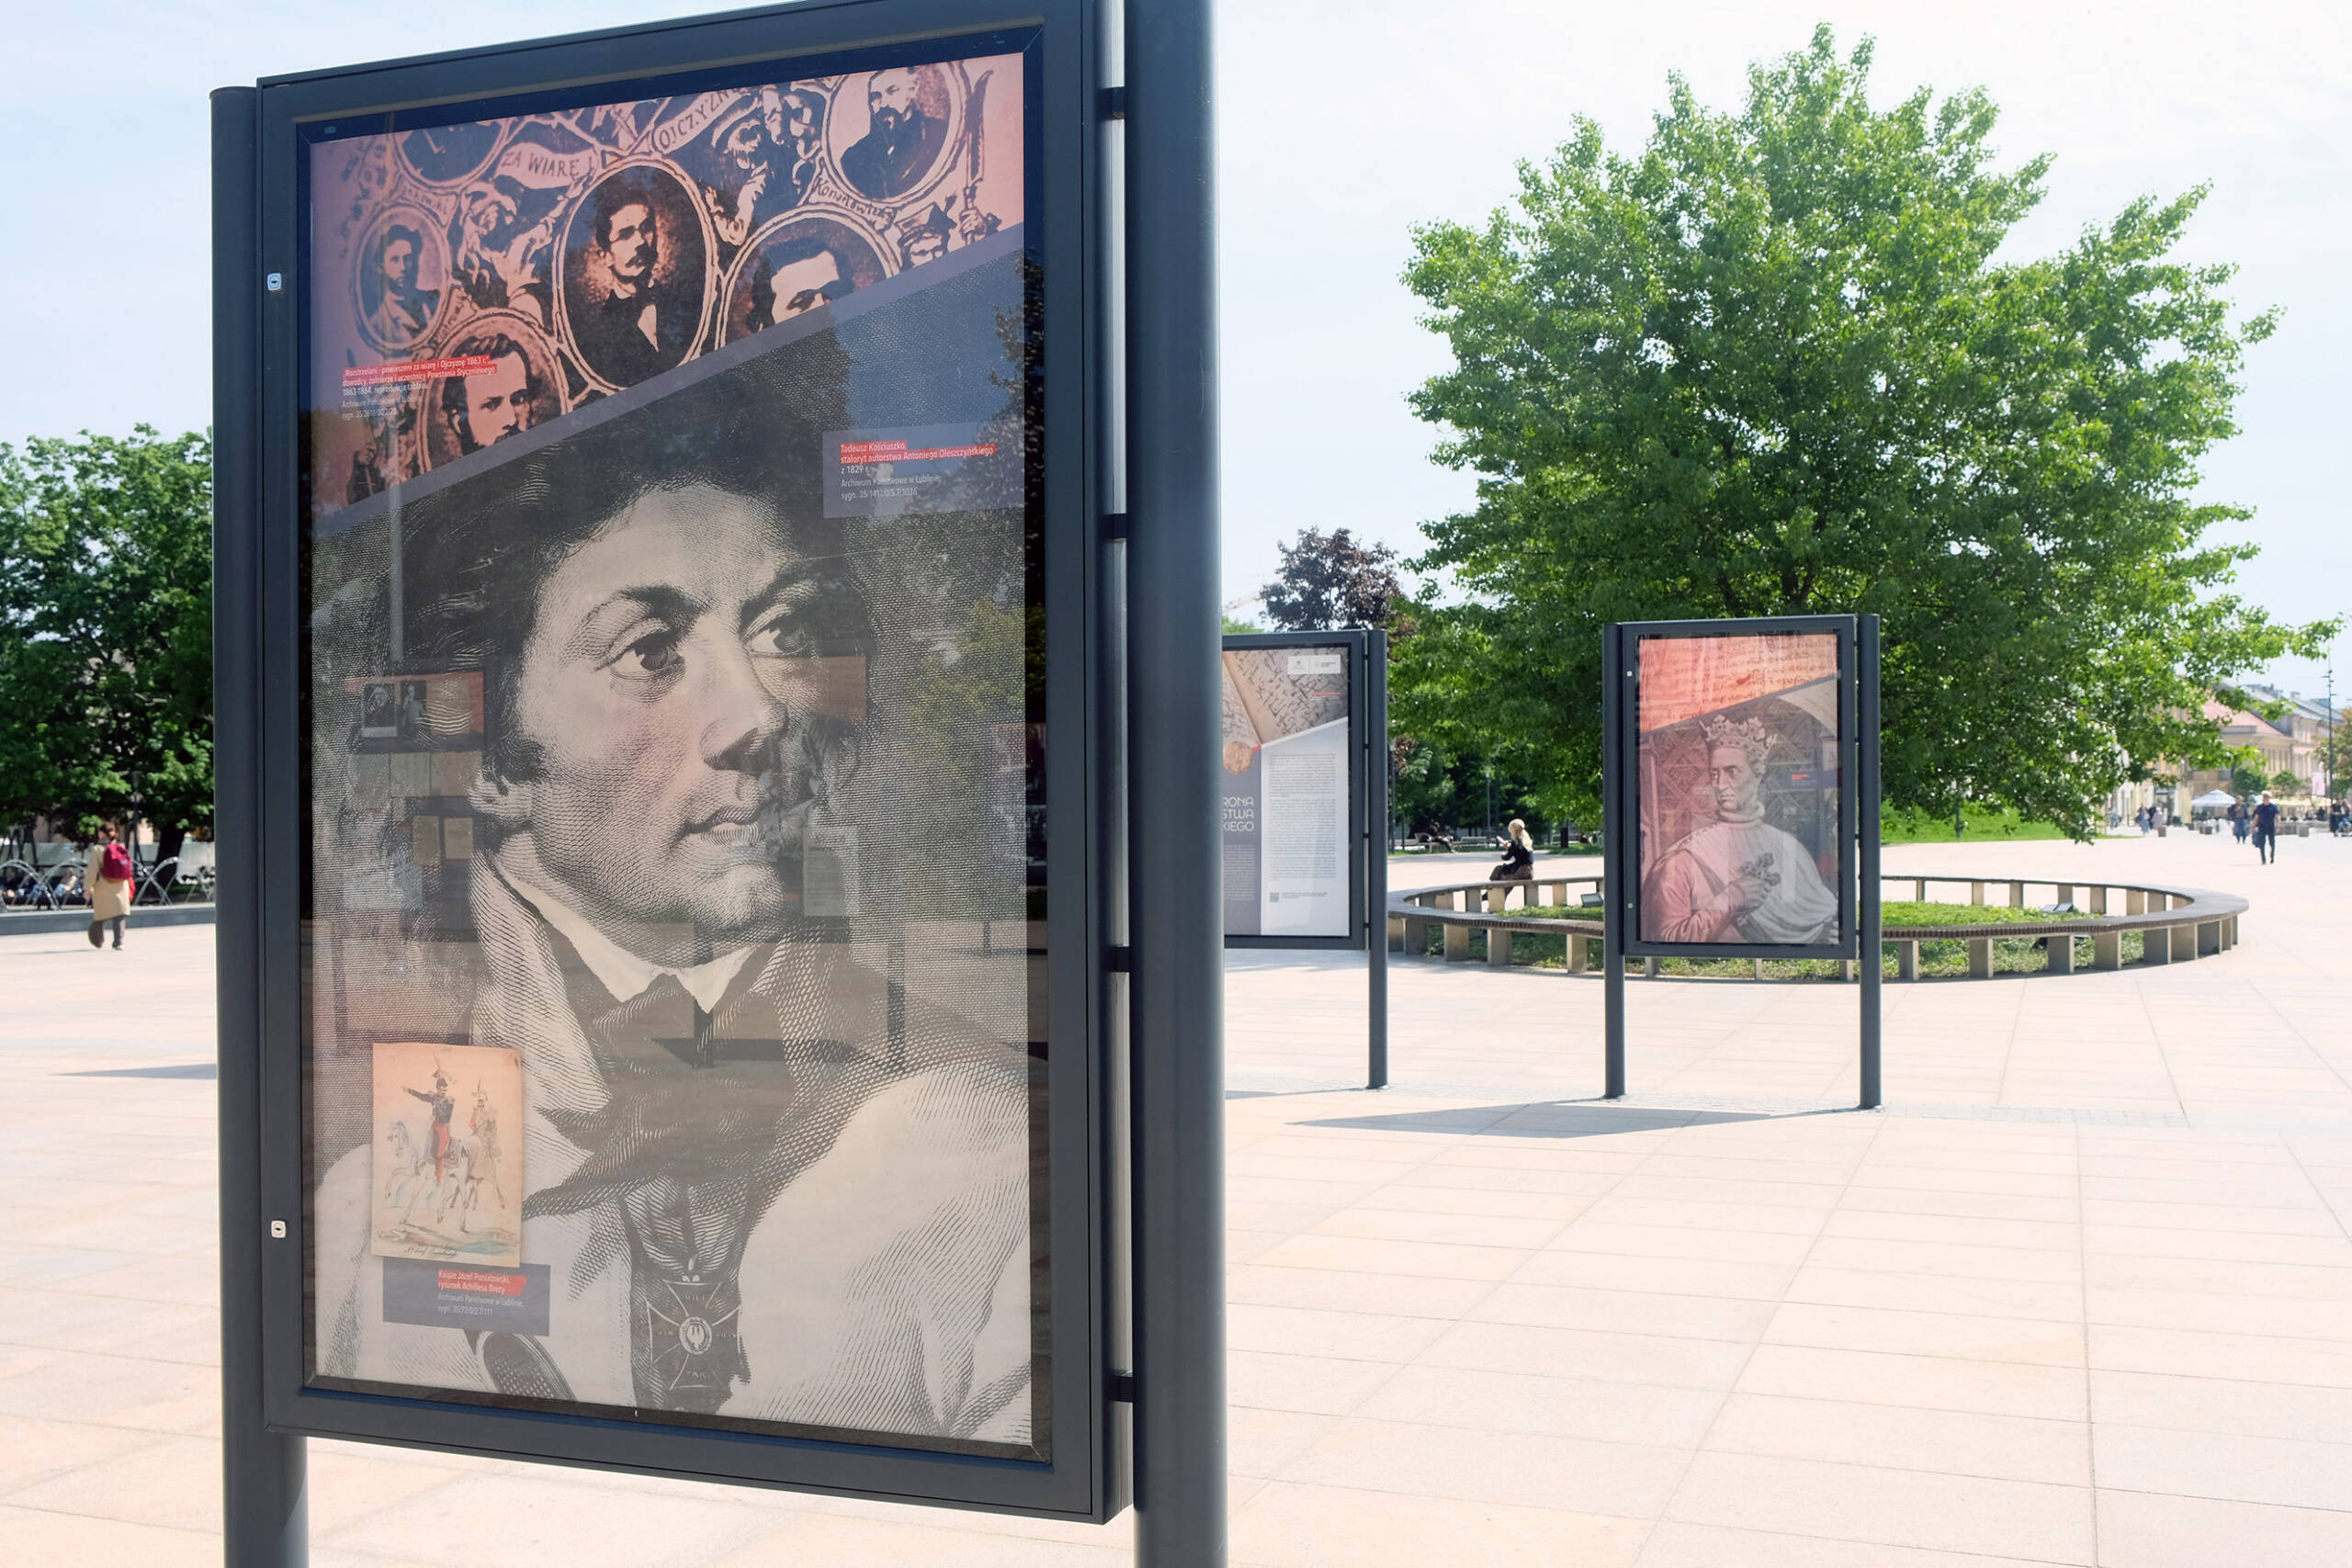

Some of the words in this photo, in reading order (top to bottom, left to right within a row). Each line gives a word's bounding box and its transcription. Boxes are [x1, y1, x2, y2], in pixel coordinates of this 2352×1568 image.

[501, 151, 521, 167] ZA
[659, 89, 738, 149] OJCZYZN
[441, 358, 466, 369] Ojczyznę
[467, 356, 481, 366] 1863
[427, 369, 456, 379] Powstania
[841, 444, 867, 453] Tadeusz
[868, 441, 908, 451] Kościuszko,
[868, 453, 902, 463] autorstwa
[903, 450, 938, 461] Antoniego
[939, 446, 993, 458] Oleszczyńskiego
[847, 465, 864, 474] 1829
